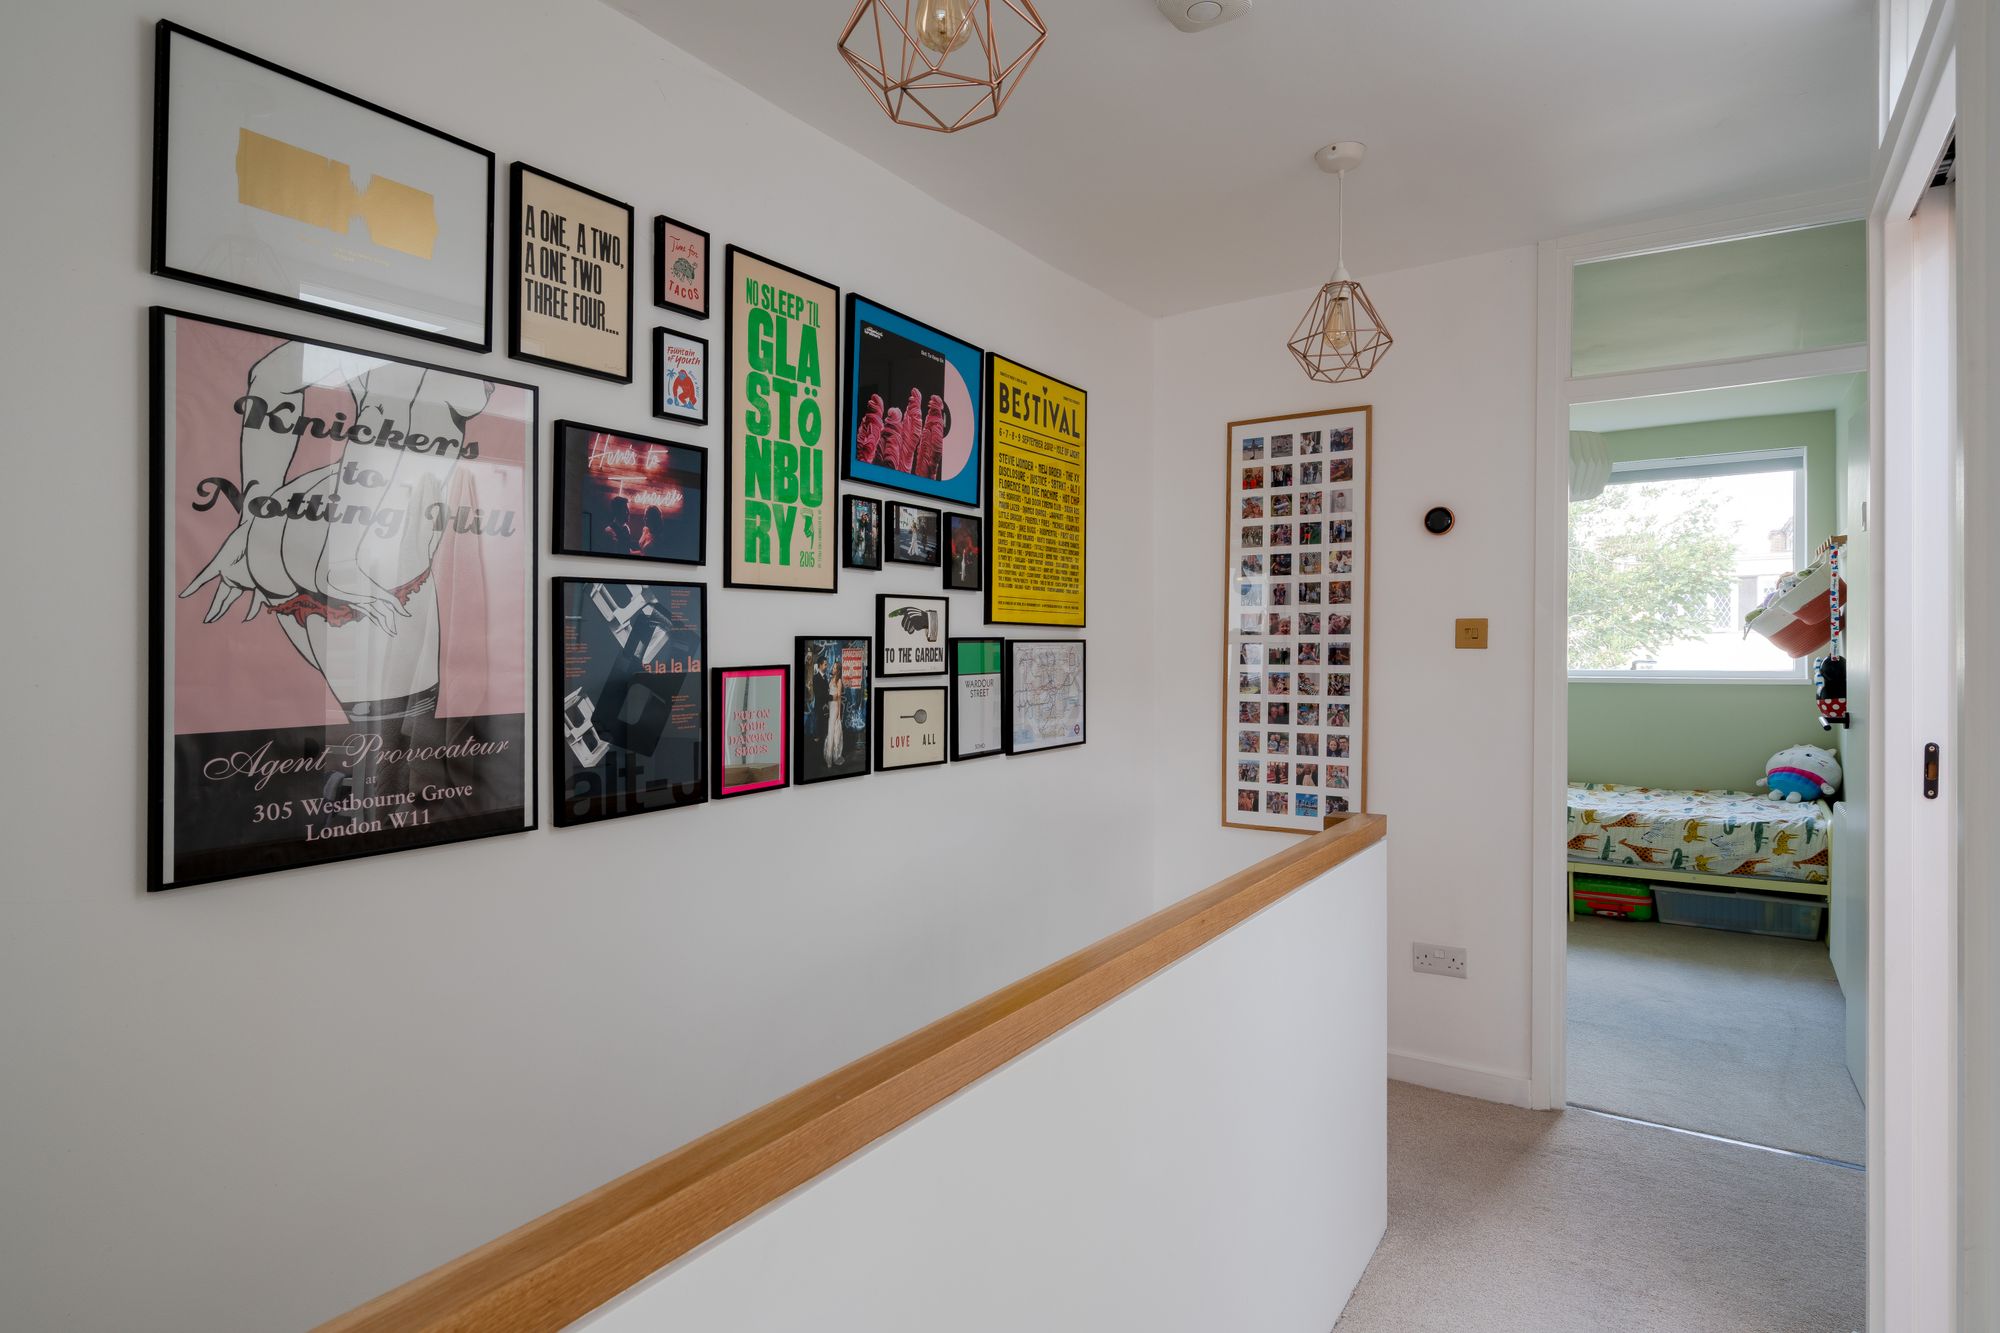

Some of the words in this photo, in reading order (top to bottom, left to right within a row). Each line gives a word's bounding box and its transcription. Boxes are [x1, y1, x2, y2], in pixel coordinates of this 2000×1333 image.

[525, 204, 535, 238] A
[540, 209, 570, 252] ONE,
[577, 223, 586, 256] A
[591, 227, 624, 270] TWO,
[524, 242, 535, 275] A
[540, 247, 567, 285] ONE
[571, 256, 602, 295] TWO
[525, 278, 568, 321] THREE
[668, 280, 700, 300] TACOS
[746, 277, 758, 307] NO
[761, 284, 804, 321] SLEEP
[667, 346, 695, 357] Fountain
[999, 382, 1080, 439] BESTIVAL
[234, 396, 479, 460] Knickers
[342, 461, 386, 489] to
[192, 477, 404, 539] Notting
[424, 500, 516, 538] Hill
[800, 550, 815, 567] 2015
[655, 660, 667, 673] la
[671, 658, 683, 673] la
[688, 656, 701, 672] la
[885, 647, 895, 663] TO
[898, 647, 912, 663] THE
[915, 647, 943, 663] GARDEN
[965, 679, 994, 689] WARDOUR
[970, 689, 989, 698] STREET
[756, 709, 770, 719] ON
[890, 735, 910, 748] LOVE
[923, 733, 936, 745] ALL
[203, 740, 332, 792] Agent
[342, 733, 510, 777] Provocateur
[365, 774, 377, 784] at
[252, 801, 293, 824] 305
[301, 787, 416, 817] Westbourne
[422, 782, 473, 802] Grove
[306, 819, 382, 842] London
[388, 809, 431, 829] W11
